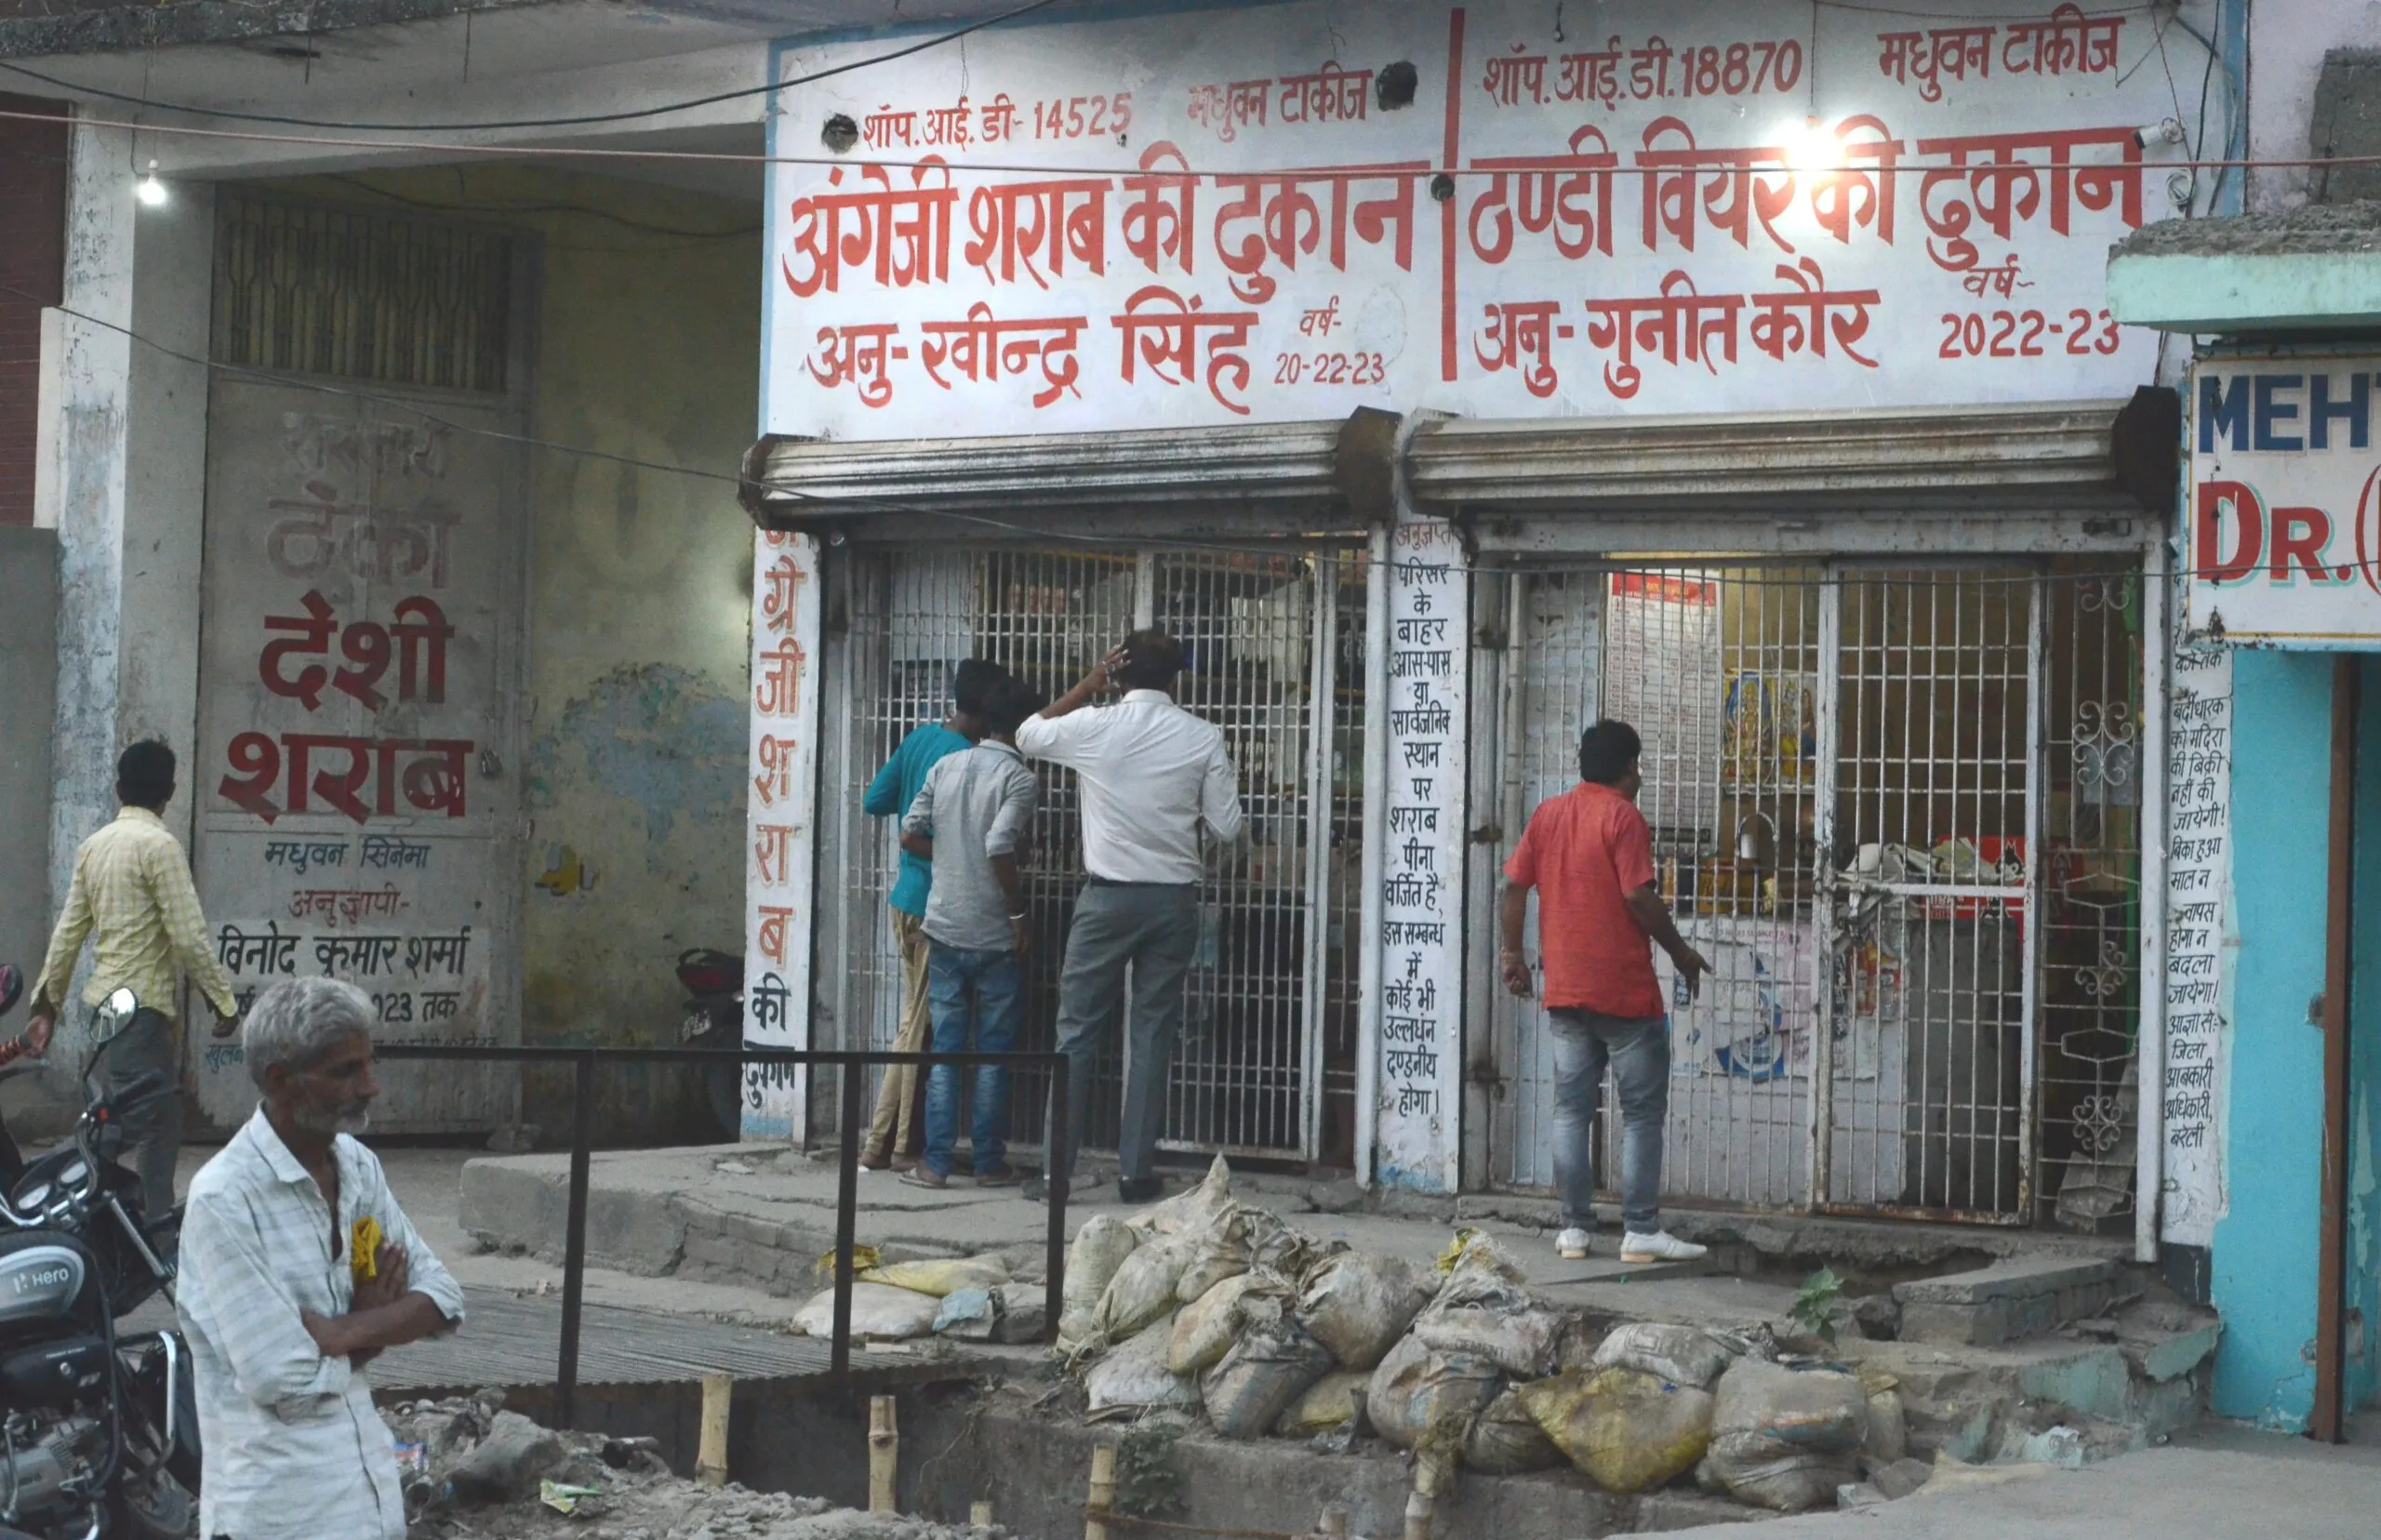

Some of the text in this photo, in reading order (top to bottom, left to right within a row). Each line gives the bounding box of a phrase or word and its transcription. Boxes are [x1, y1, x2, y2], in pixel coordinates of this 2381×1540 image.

[1877, 2, 2126, 101] मधुवन टाकीज
[1681, 38, 1802, 98] 18870
[1033, 93, 1131, 140] 14525
[1188, 60, 1374, 142] मधुवन टाकीज
[1469, 124, 1618, 265] ठण्डी
[1811, 113, 1905, 247] की
[1918, 125, 2143, 272] दुकान
[964, 179, 1114, 291] शराब
[1122, 140, 1201, 276] की
[1214, 160, 1432, 305] दुकान
[1586, 270, 1746, 400] गुनीत
[1751, 257, 1882, 368] कौर
[1939, 308, 2120, 359] 2022-23
[922, 302, 1088, 409] रवीन्द्र
[1111, 285, 1259, 416] सिंह
[1274, 352, 1386, 386] 20-22-23
[2198, 374, 2381, 453] MEH
[1395, 556, 1450, 587] परिसर
[1414, 588, 1431, 616] के
[1397, 618, 1447, 645] बाहर
[259, 589, 456, 712] देशी
[1414, 682, 1430, 705] या
[1391, 699, 1451, 737] सार्वजनिक
[2172, 723, 2226, 751] को मदिरा
[1403, 742, 1443, 769] स्थान
[2171, 750, 2186, 777] की
[218, 732, 474, 826] शराब
[1412, 777, 1433, 802] पर
[2171, 777, 2217, 807] नहीं की
[1390, 807, 1441, 834] शराब
[265, 837, 431, 874] मधुवन सिनेमा
[1403, 836, 1435, 872] पीना
[2170, 834, 2223, 864] बिका हुआ
[1385, 872, 1423, 908] वर्जित
[2171, 869, 2212, 892] माल न
[2184, 901, 2217, 923] वापस
[218, 920, 471, 978] विनोद कुमार शर्मा
[1384, 921, 1445, 948] इस सम्बन्ध
[2169, 926, 2210, 953] होगा न
[1406, 951, 1422, 980] में
[2168, 954, 2215, 977] बदला
[420, 991, 460, 1022] तक
[752, 972, 791, 1032] की
[1385, 978, 1436, 1014] कोई भी
[2168, 1013, 2199, 1038] आज्ञा
[1387, 1043, 1439, 1080] दण्डनीय
[2171, 1039, 2207, 1061] जिला
[2165, 1056, 2214, 1090] आबकारी
[2170, 1121, 2206, 1149] बरेली
[33, 1268, 69, 1287] Hero
